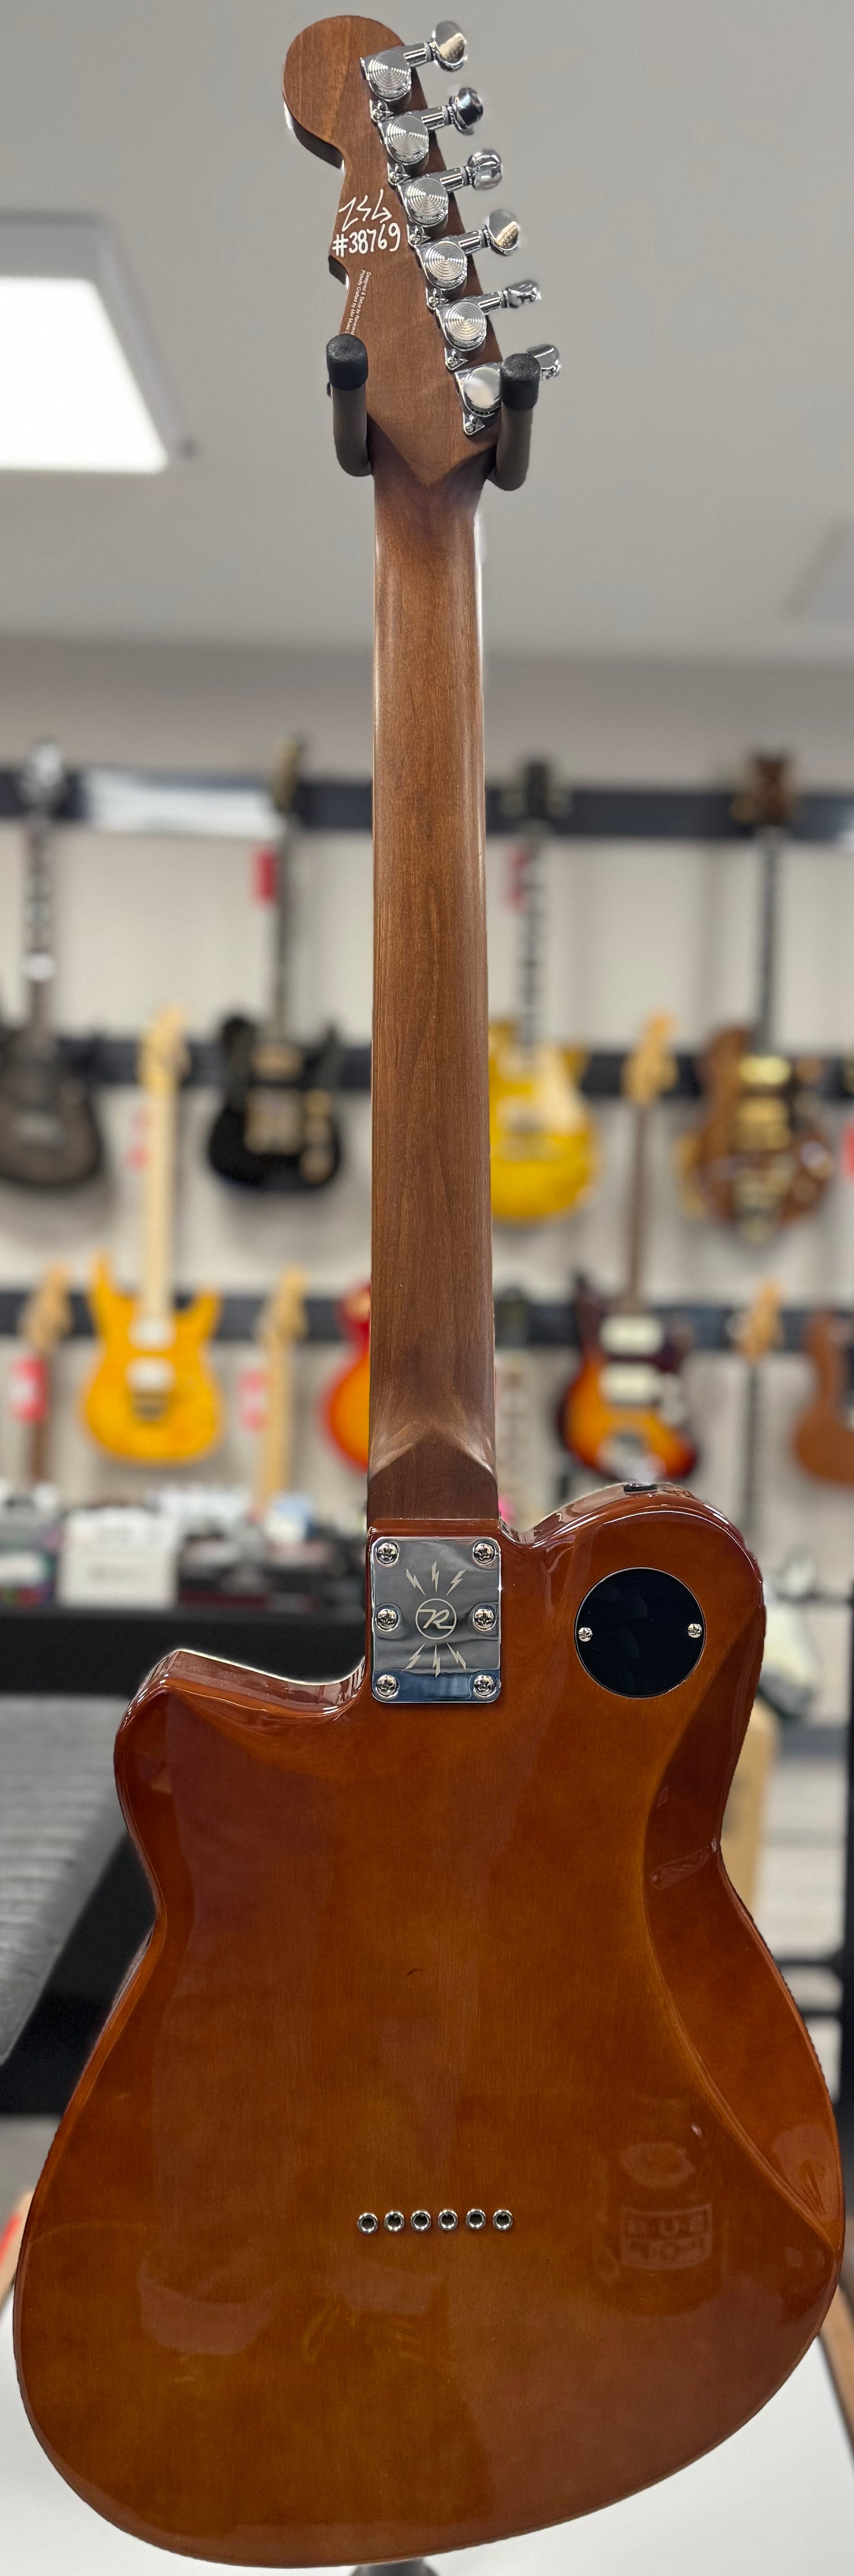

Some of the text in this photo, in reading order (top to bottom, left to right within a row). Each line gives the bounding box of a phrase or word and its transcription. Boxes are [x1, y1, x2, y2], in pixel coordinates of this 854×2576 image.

[332, 222, 401, 258] #38769
[357, 269, 366, 286] Proudly
[362, 271, 371, 291] Designed
